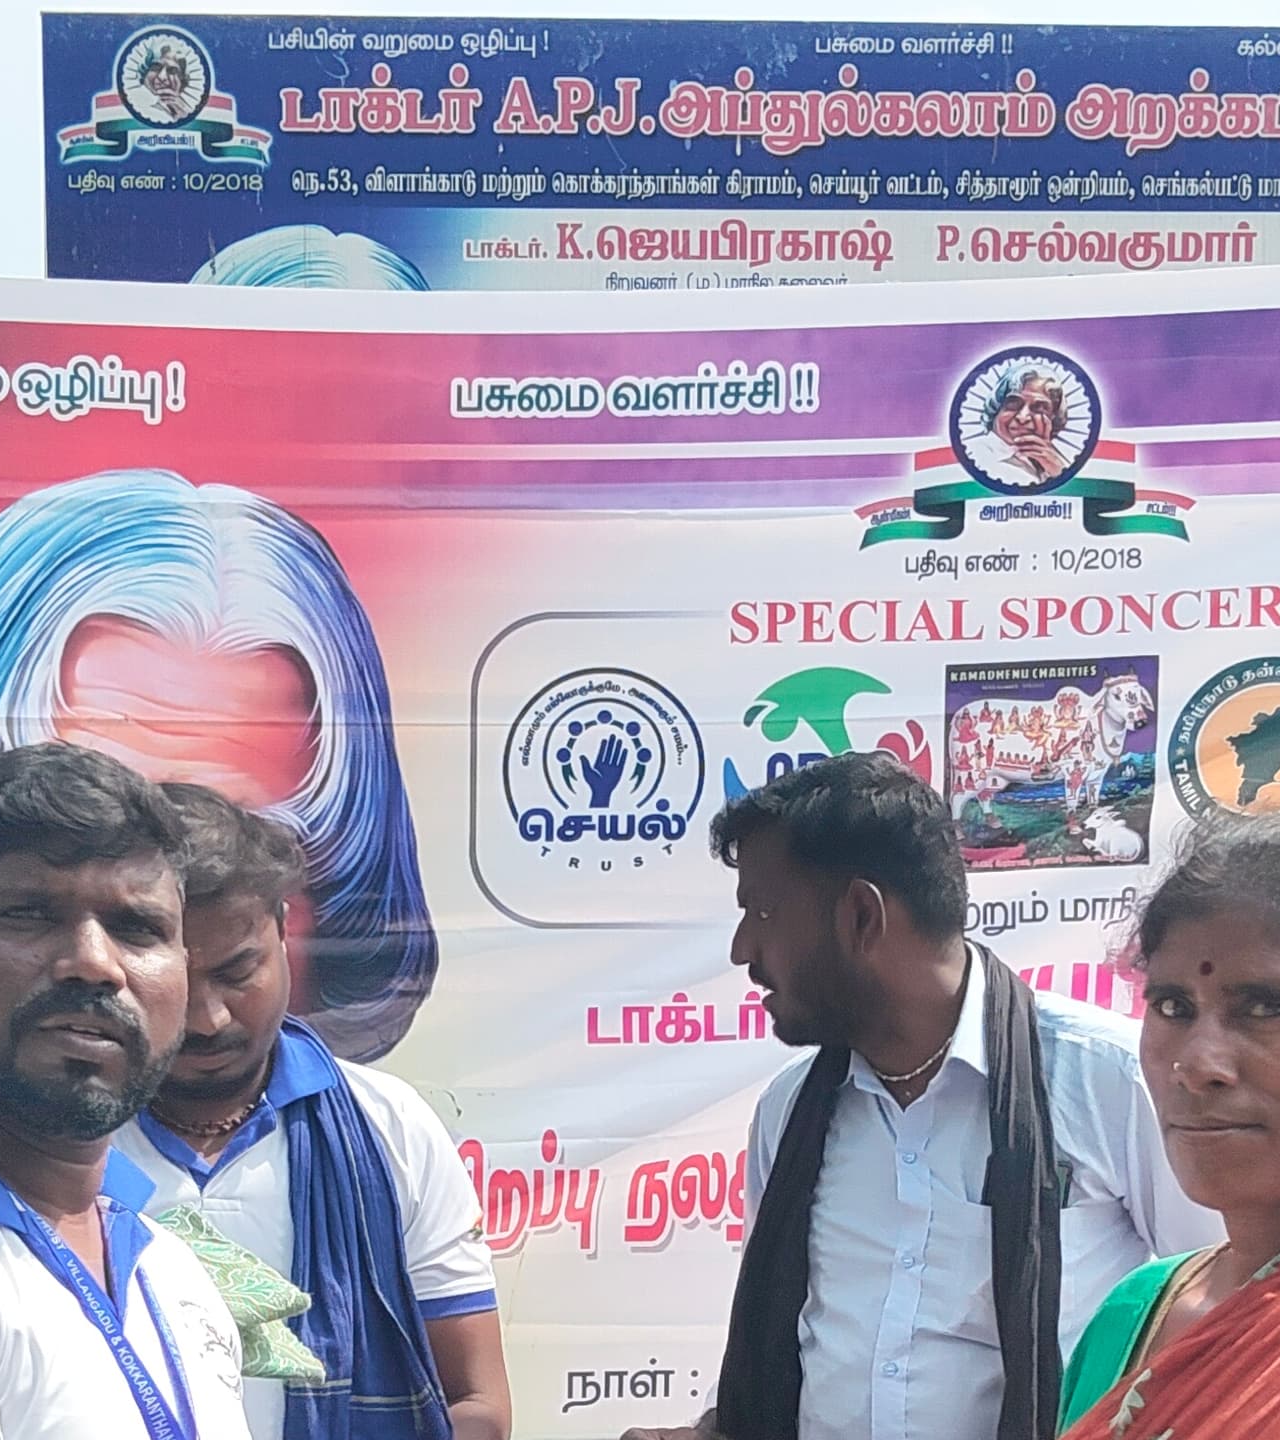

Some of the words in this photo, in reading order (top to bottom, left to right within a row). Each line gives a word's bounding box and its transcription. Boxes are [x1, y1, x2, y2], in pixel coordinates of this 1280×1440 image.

[269, 27, 357, 53] பசியின்
[362, 32, 454, 57] வறுமை
[460, 28, 537, 57] ஒழிப்பு
[815, 35, 895, 55] பசுமை
[901, 31, 995, 55] வளர்ச்சி
[280, 63, 483, 134] டாக்டர்
[68, 168, 115, 195] பதிவு
[120, 168, 166, 191] எண்
[183, 173, 264, 191] 10/2018
[365, 165, 477, 196] விளாங்காடு
[482, 167, 547, 200] மற்றும்
[726, 168, 803, 200] கிராமம்,
[810, 168, 881, 203] செய்யூர்
[886, 169, 949, 198] வட்டம்,
[955, 169, 1042, 201] சித்தாமூர்
[1047, 169, 1135, 203] ஒன்றியம்,
[1141, 170, 1252, 201] செங்கல்பட்டு
[555, 218, 895, 272] K.ஜெயபிரகாஷ்
[936, 221, 1258, 271] P.செல்வகுமார்
[16, 359, 158, 420] ஒழிப்பு
[454, 380, 601, 414] பசுமை
[611, 365, 783, 413] வளர்ச்சி
[904, 549, 959, 582] பதிவு
[964, 547, 1020, 573] எண்
[1051, 545, 1144, 575] 10/2018
[729, 599, 985, 645] SPECIAL
[950, 667, 1030, 683] KAMADHENU
[1031, 664, 1098, 680] CHARITIES
[1174, 759, 1199, 812] TAMIL
[518, 798, 687, 843] செயல்
[540, 843, 674, 873] TRUST
[586, 989, 768, 1044] டாக்டர்
[66, 1257, 118, 1336] VILLANGADU
[562, 1357, 676, 1414] நாள்
